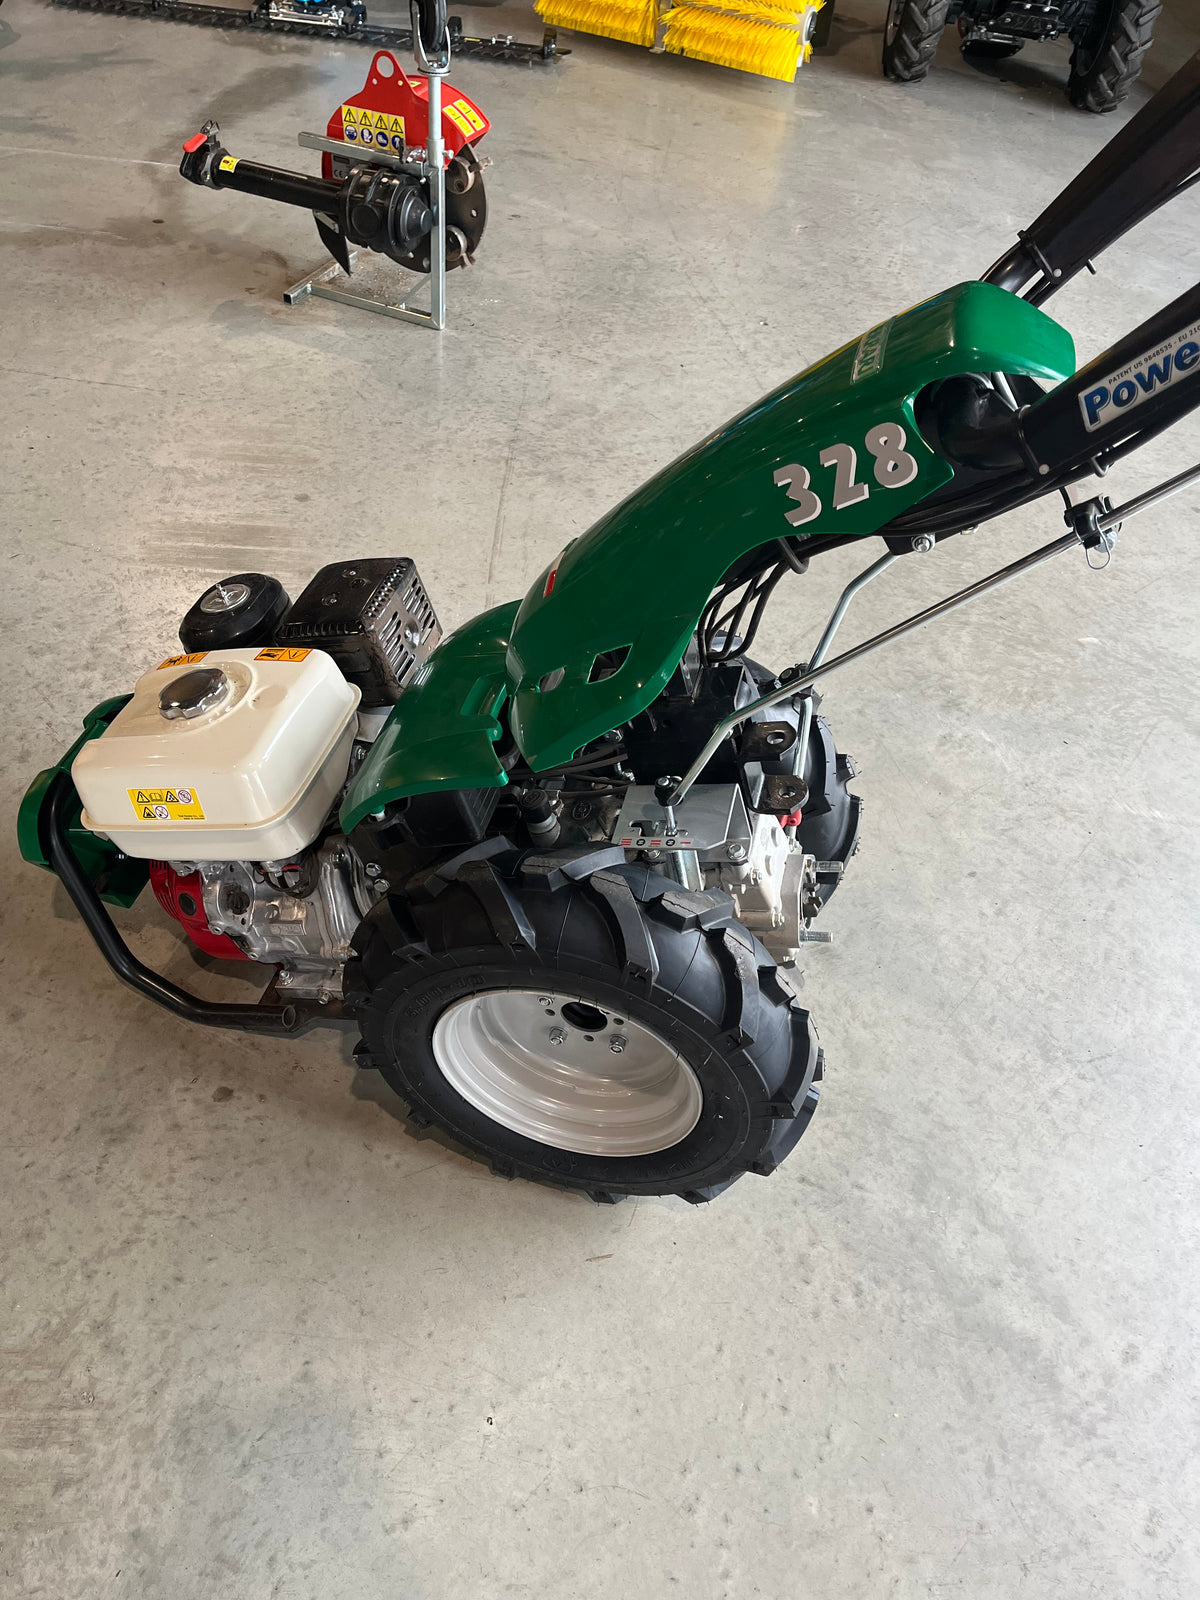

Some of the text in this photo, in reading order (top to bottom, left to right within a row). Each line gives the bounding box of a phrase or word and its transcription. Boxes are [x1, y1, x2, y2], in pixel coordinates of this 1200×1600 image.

[1084, 341, 1200, 427] Powe
[1108, 367, 1132, 385] PATENT
[1133, 361, 1143, 370] US
[1144, 342, 1173, 363] 9848535
[1178, 333, 1188, 343] EU
[773, 422, 918, 527] 328
